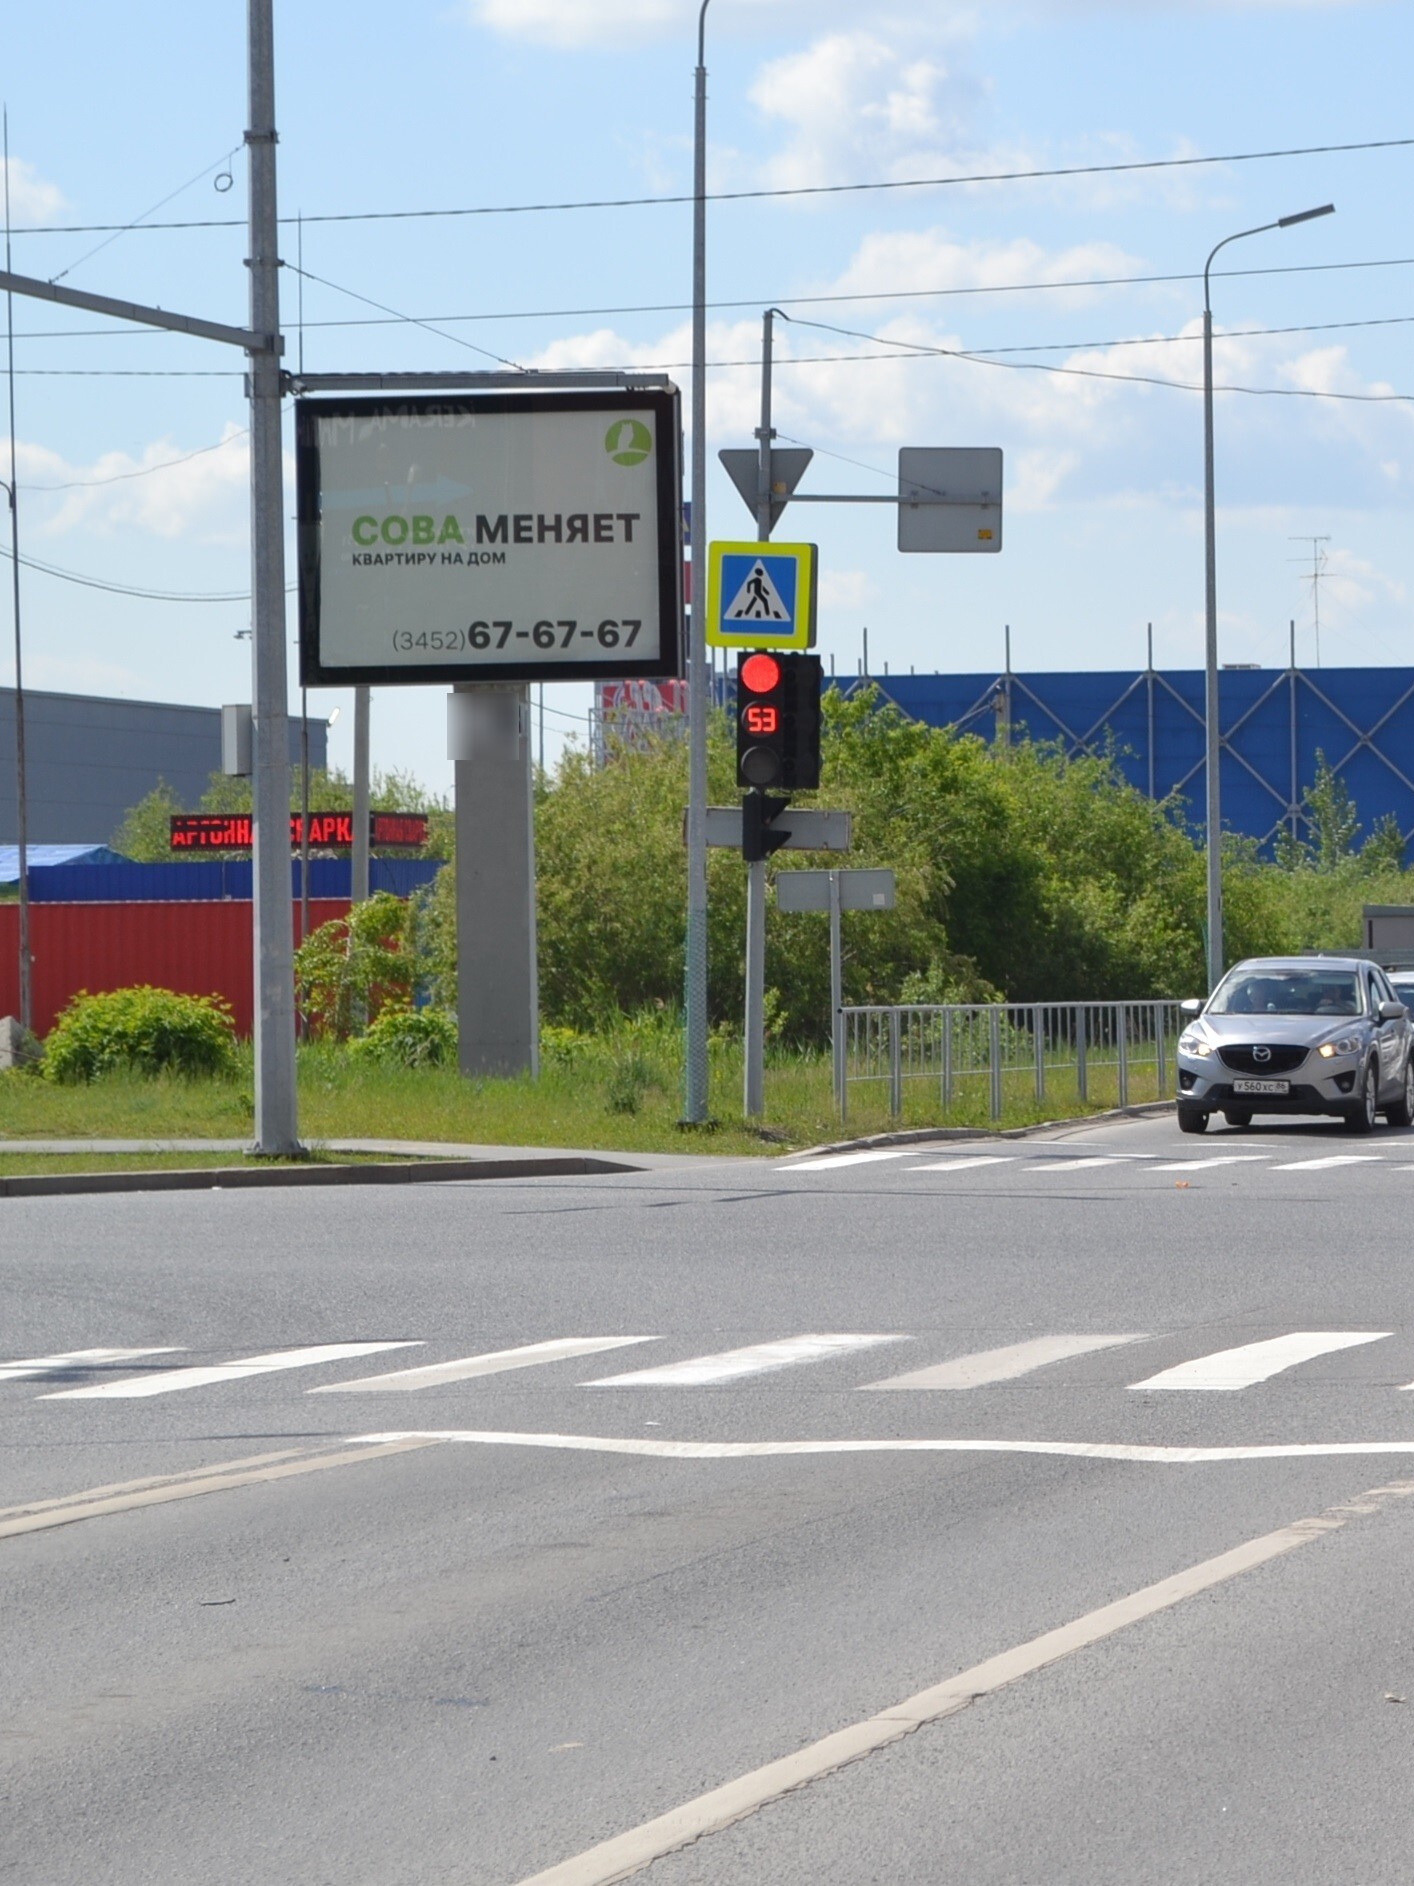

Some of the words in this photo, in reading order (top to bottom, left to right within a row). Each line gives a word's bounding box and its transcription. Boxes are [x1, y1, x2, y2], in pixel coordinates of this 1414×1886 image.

[351, 515, 464, 546] СОВА
[475, 513, 640, 544] МЕНЯЕТ
[352, 553, 436, 566] КВАРТИРУ
[441, 553, 463, 565] НА
[467, 552, 506, 566] ДОМ
[392, 630, 465, 651] (3452)
[467, 620, 642, 649] 67-67-67
[748, 708, 776, 732] 53
